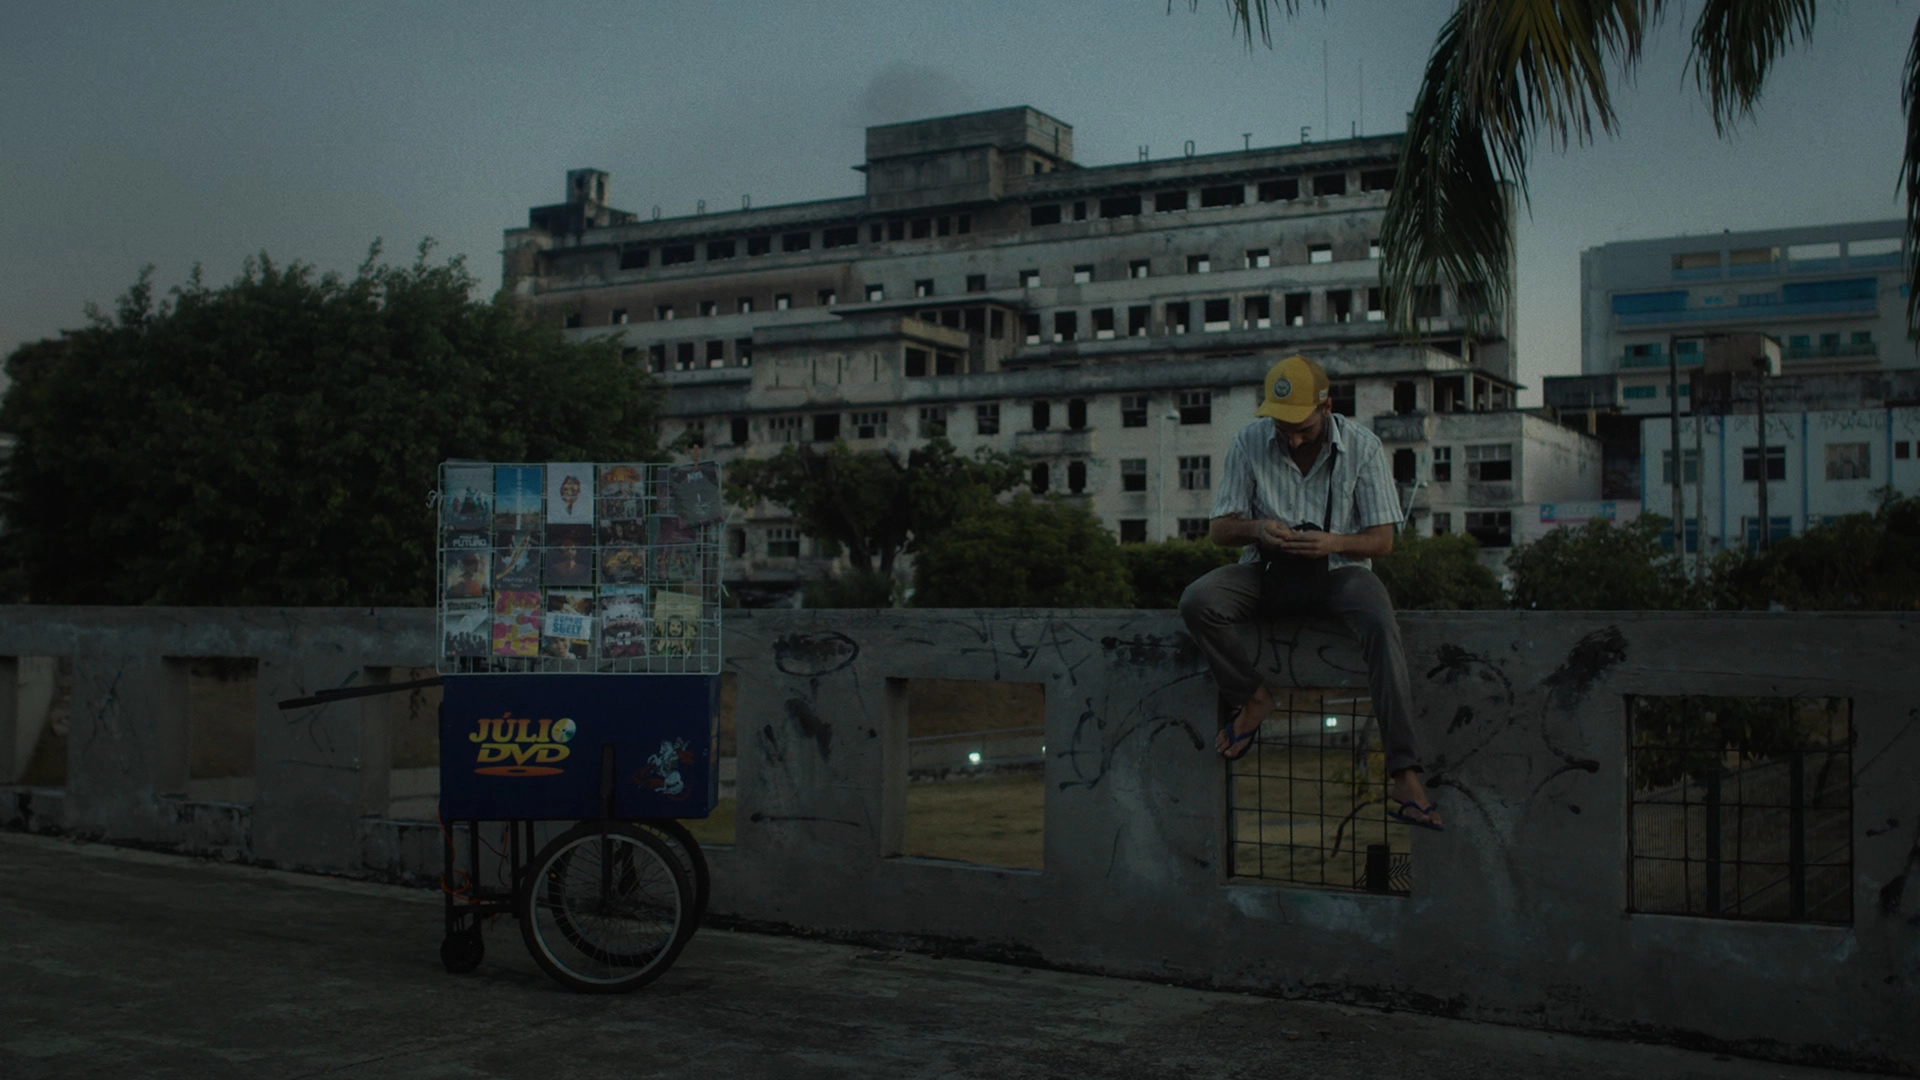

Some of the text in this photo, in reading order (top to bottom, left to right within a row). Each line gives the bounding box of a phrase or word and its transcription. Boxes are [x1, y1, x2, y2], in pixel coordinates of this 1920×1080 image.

[1138, 120, 1362, 163] HOTEL
[468, 711, 577, 743] JÚLIO
[476, 743, 571, 766] DVD
